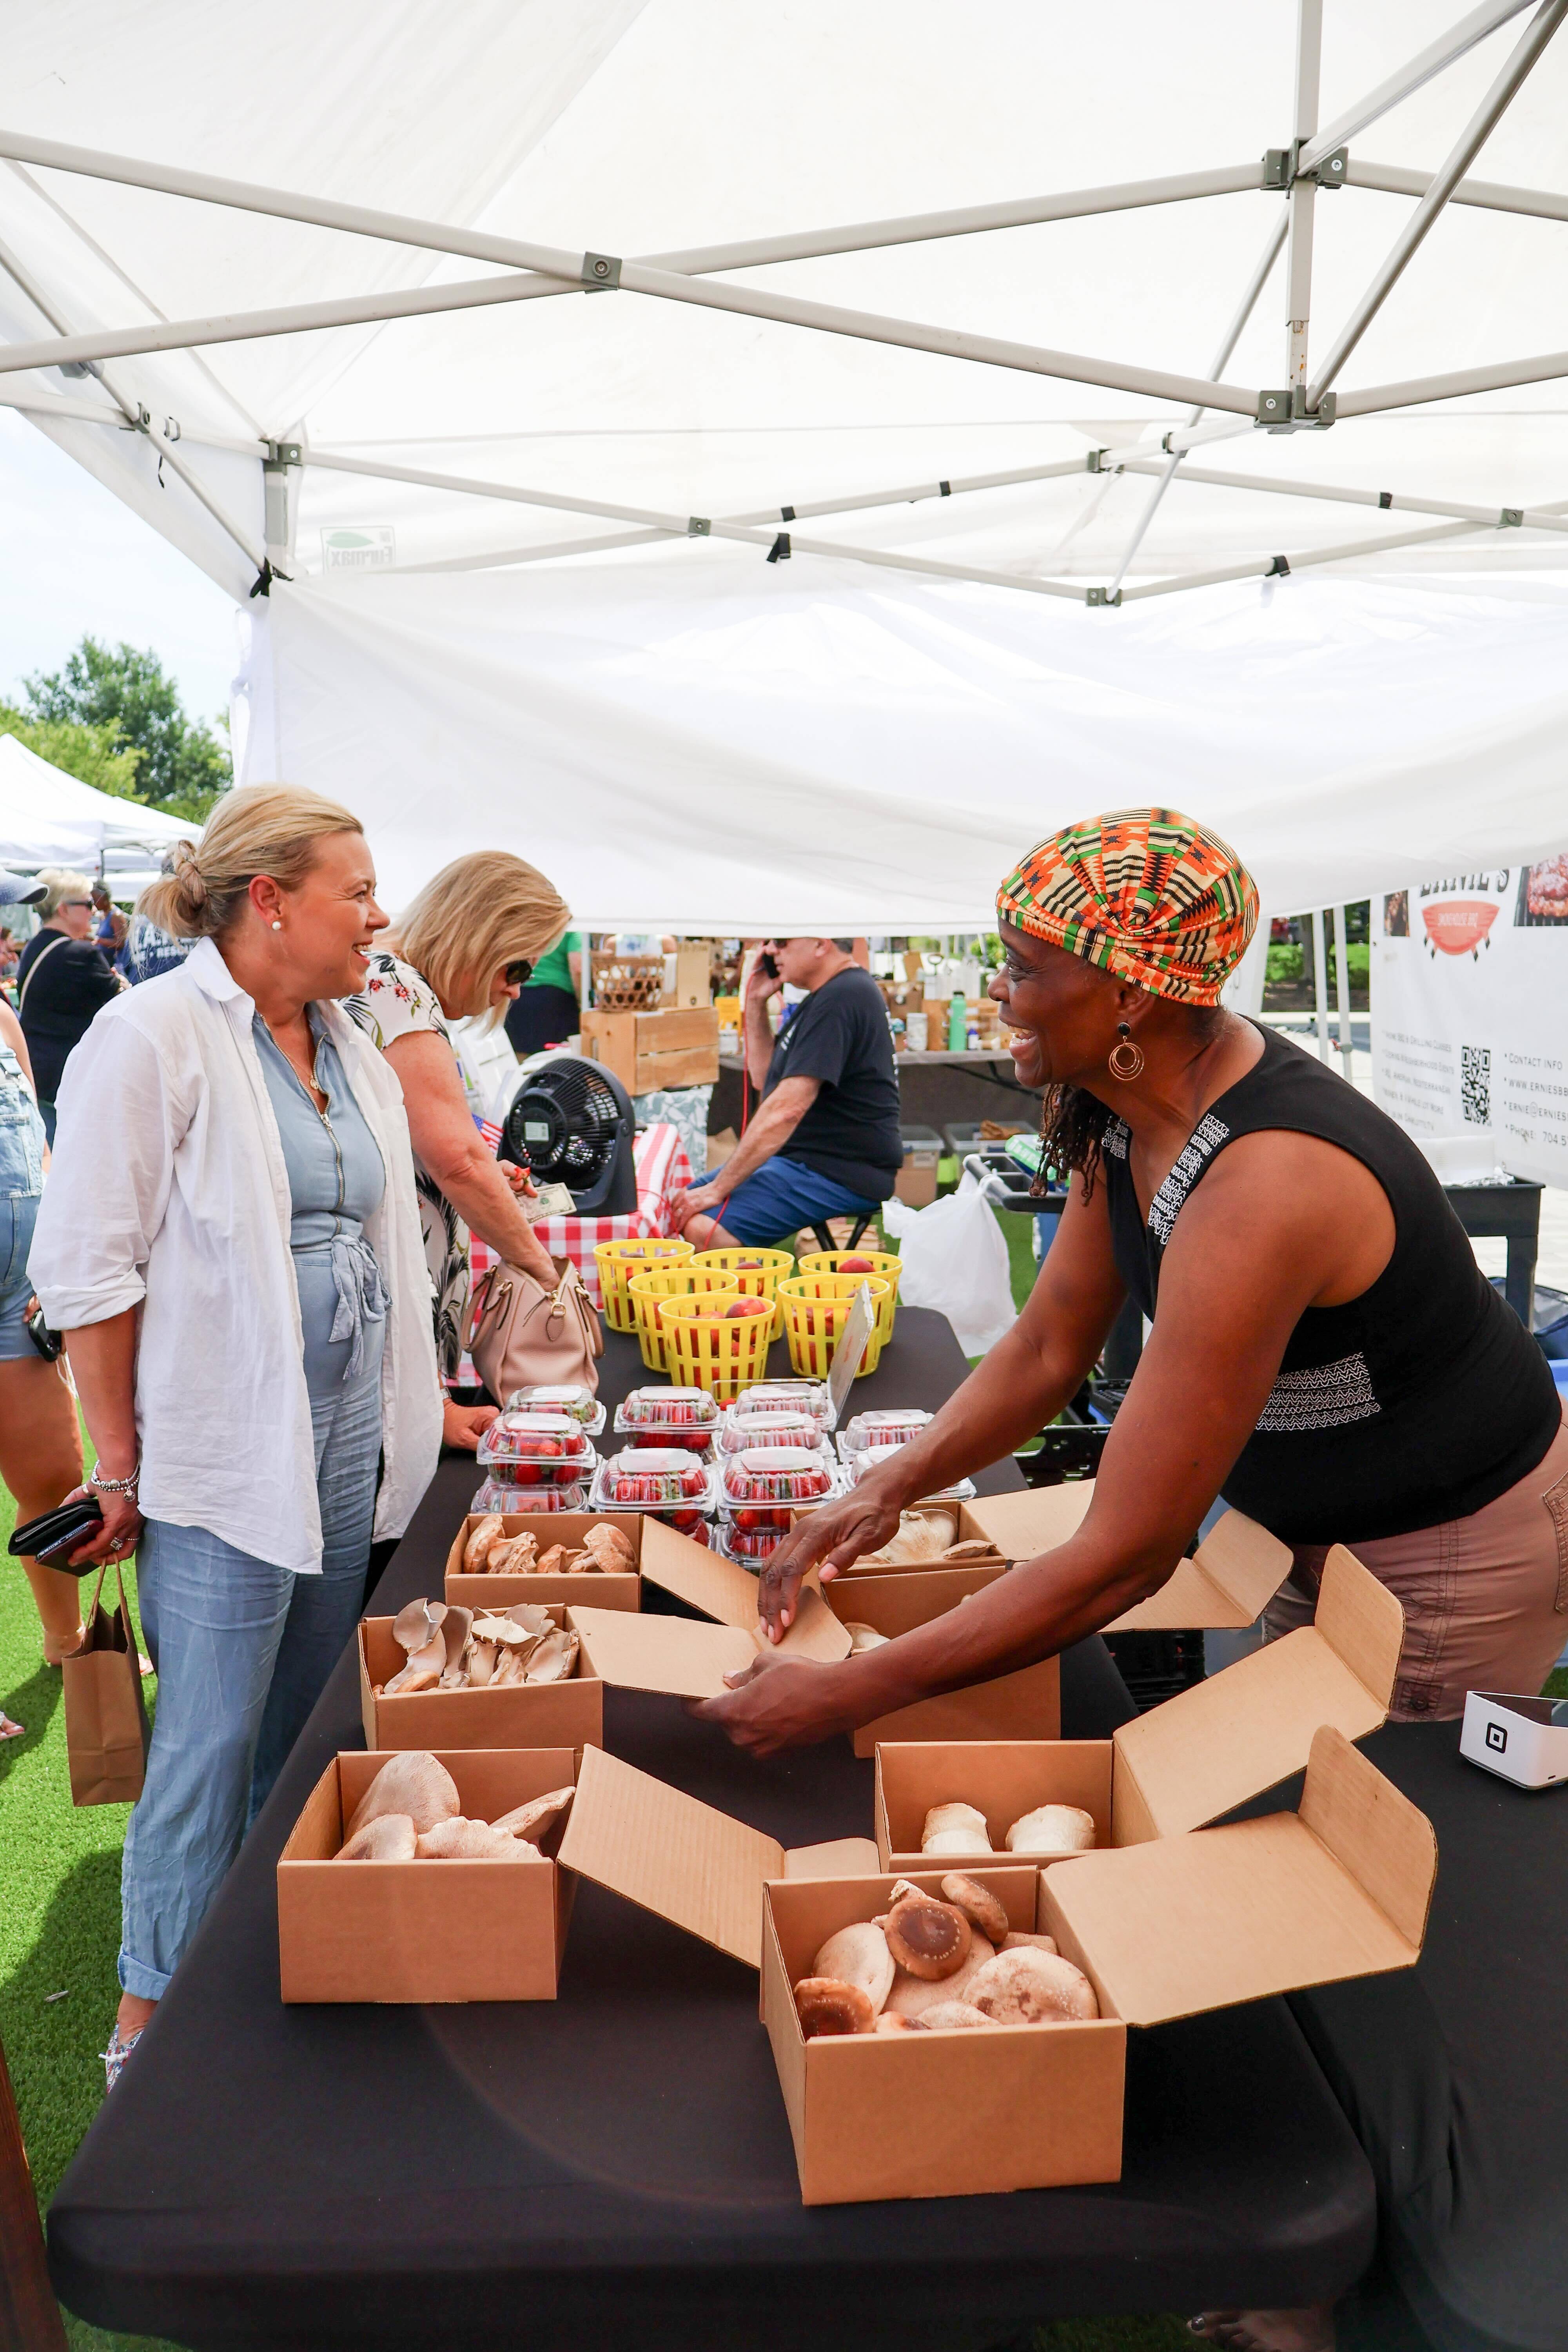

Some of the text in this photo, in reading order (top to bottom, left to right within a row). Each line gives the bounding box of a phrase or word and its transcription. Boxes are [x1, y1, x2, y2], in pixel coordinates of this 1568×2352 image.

[1509, 1053, 1563, 1070] CONTACT INFO
[1508, 1102, 1568, 1121] ERNIE@ERNIES
[1543, 1131, 1568, 1146] 704.5
